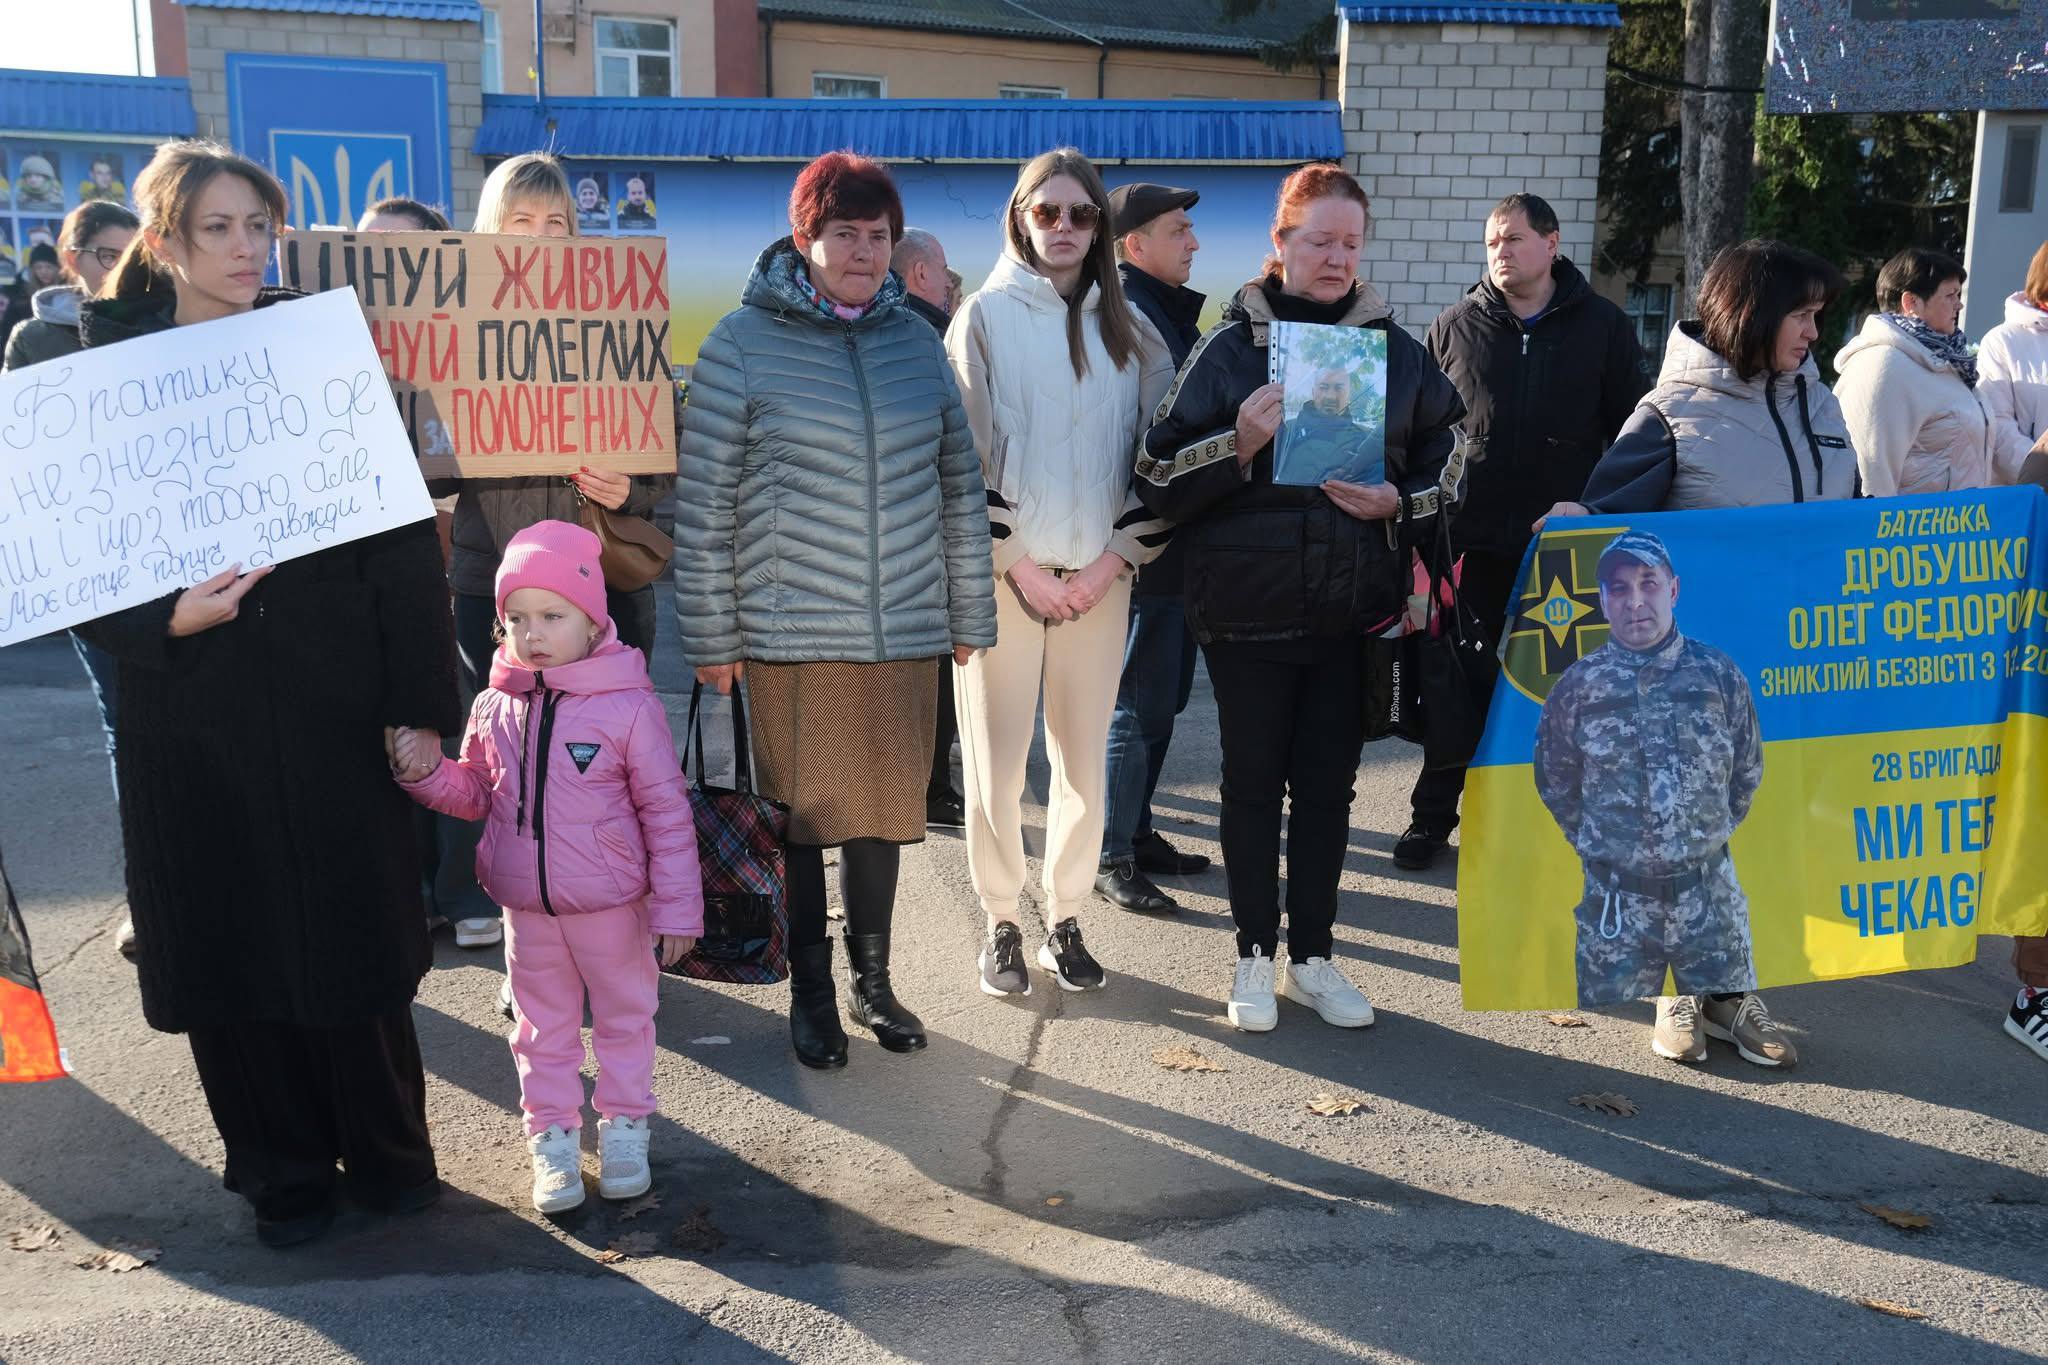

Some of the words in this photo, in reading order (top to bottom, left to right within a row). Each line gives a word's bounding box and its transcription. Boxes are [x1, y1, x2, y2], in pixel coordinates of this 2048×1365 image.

[491, 244, 671, 312] ЖИВИХ
[371, 313, 459, 383] НУЙ
[478, 318, 673, 383] ПОЛЕГЛИХ
[3, 347, 281, 450] Братику
[319, 371, 376, 454] де
[450, 384, 664, 456] ПОЛОНЕНИХ
[180, 460, 290, 533] тобою
[304, 447, 370, 492] але
[1877, 503, 1990, 538] БАТЕНЬКА
[66, 564, 131, 612] серце
[153, 540, 226, 584] поруч
[1842, 536, 2029, 596] ДРОБУШКО
[1788, 602, 1874, 649] ОЛЕГ
[1761, 656, 1870, 697] ЗНИКЛИЙ
[1876, 652, 1975, 688] БЕЗВІСТІ
[1872, 752, 1902, 783] 28
[1909, 743, 2001, 780] БРИГАДА
[1853, 803, 1923, 863] МИ
[1935, 792, 1998, 854] ТЕБ
[1840, 866, 1987, 938] ЧЕКАЄ
